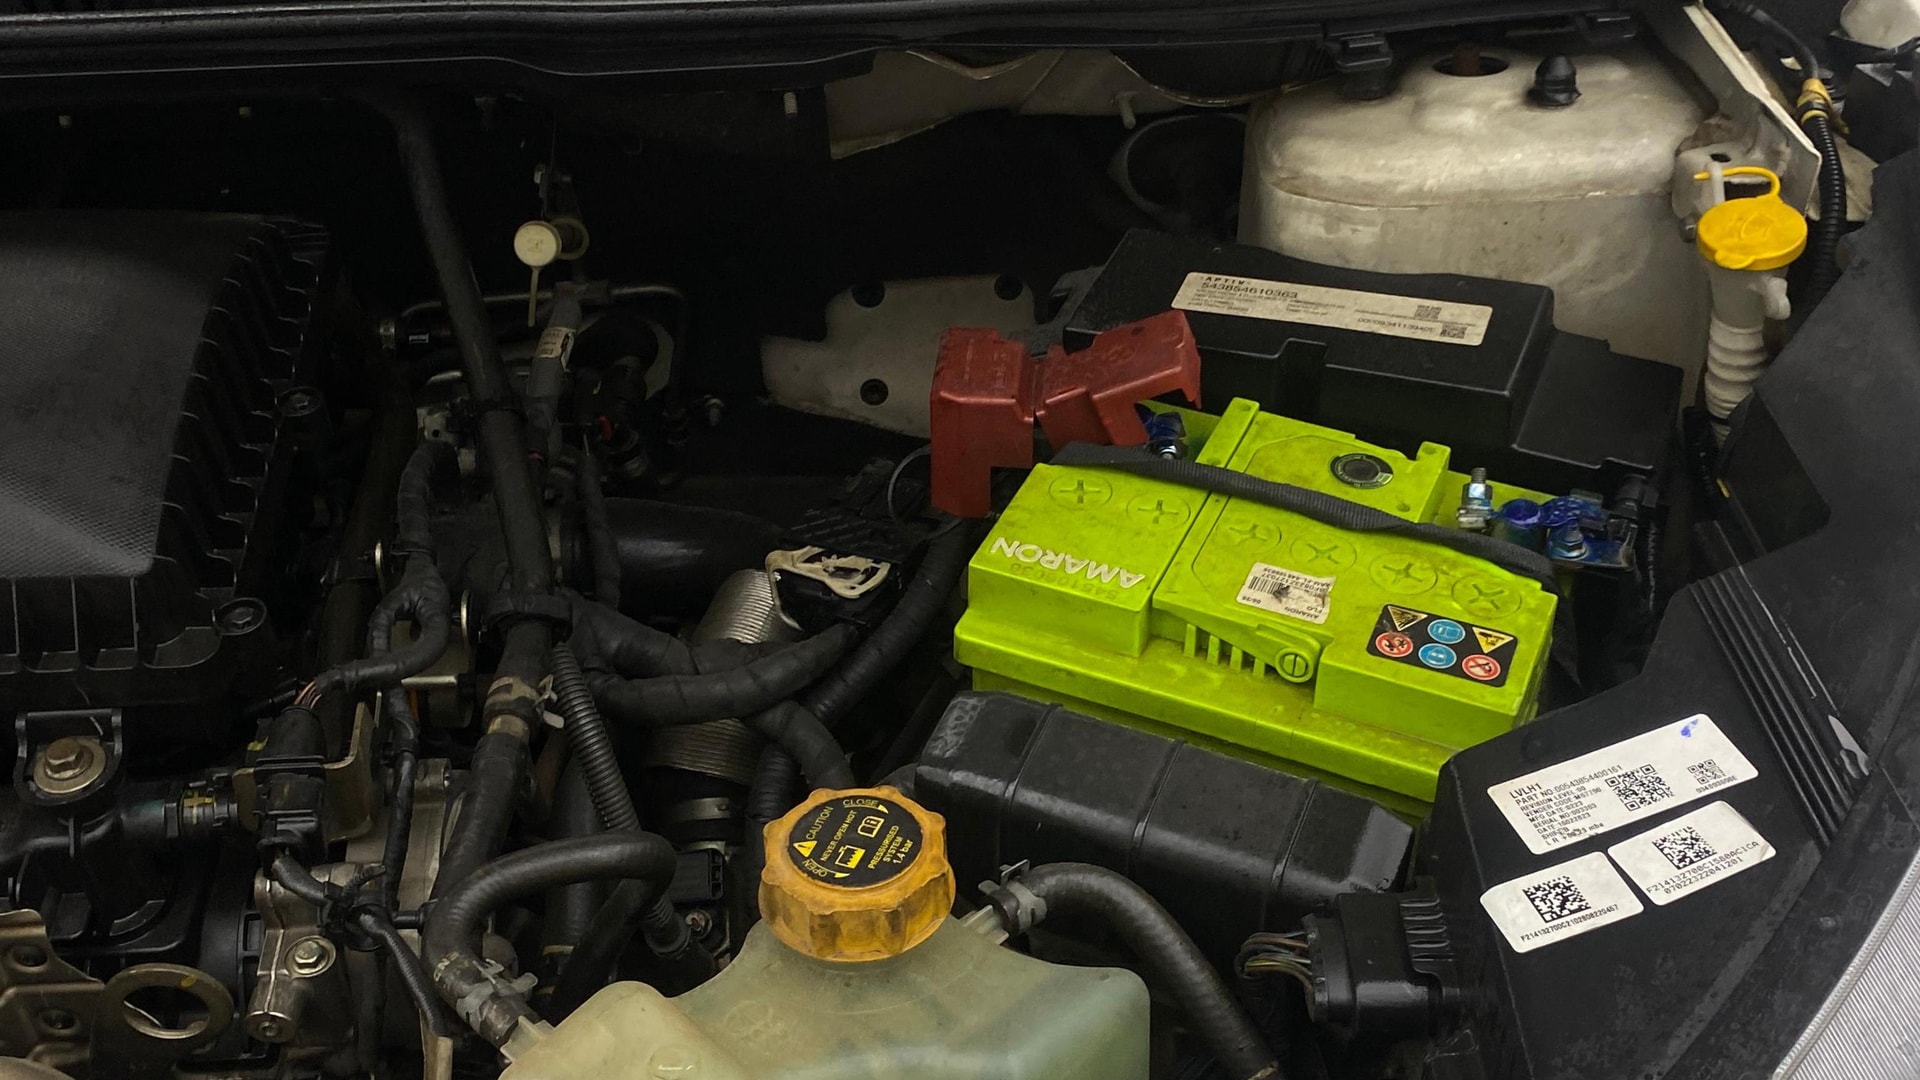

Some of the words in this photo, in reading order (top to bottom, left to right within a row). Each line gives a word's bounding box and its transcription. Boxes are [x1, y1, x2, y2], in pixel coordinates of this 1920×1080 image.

[990, 537, 1146, 589] AMARON
[1509, 783, 1542, 799] LVLH1
[1515, 794, 1538, 806] PART
[843, 799, 879, 808] CLOSE
[806, 806, 834, 840] CAUTION
[1528, 813, 1545, 823] MFG
[1533, 817, 1557, 828] SERIAL
[820, 839, 839, 861] NEVER
[835, 822, 849, 842] OPEN
[845, 809, 858, 824] HOT
[867, 825, 899, 870] PRESSURISED
[883, 836, 903, 862] SYSTEM
[902, 839, 914, 853] bar
[802, 858, 828, 878] OPEN
